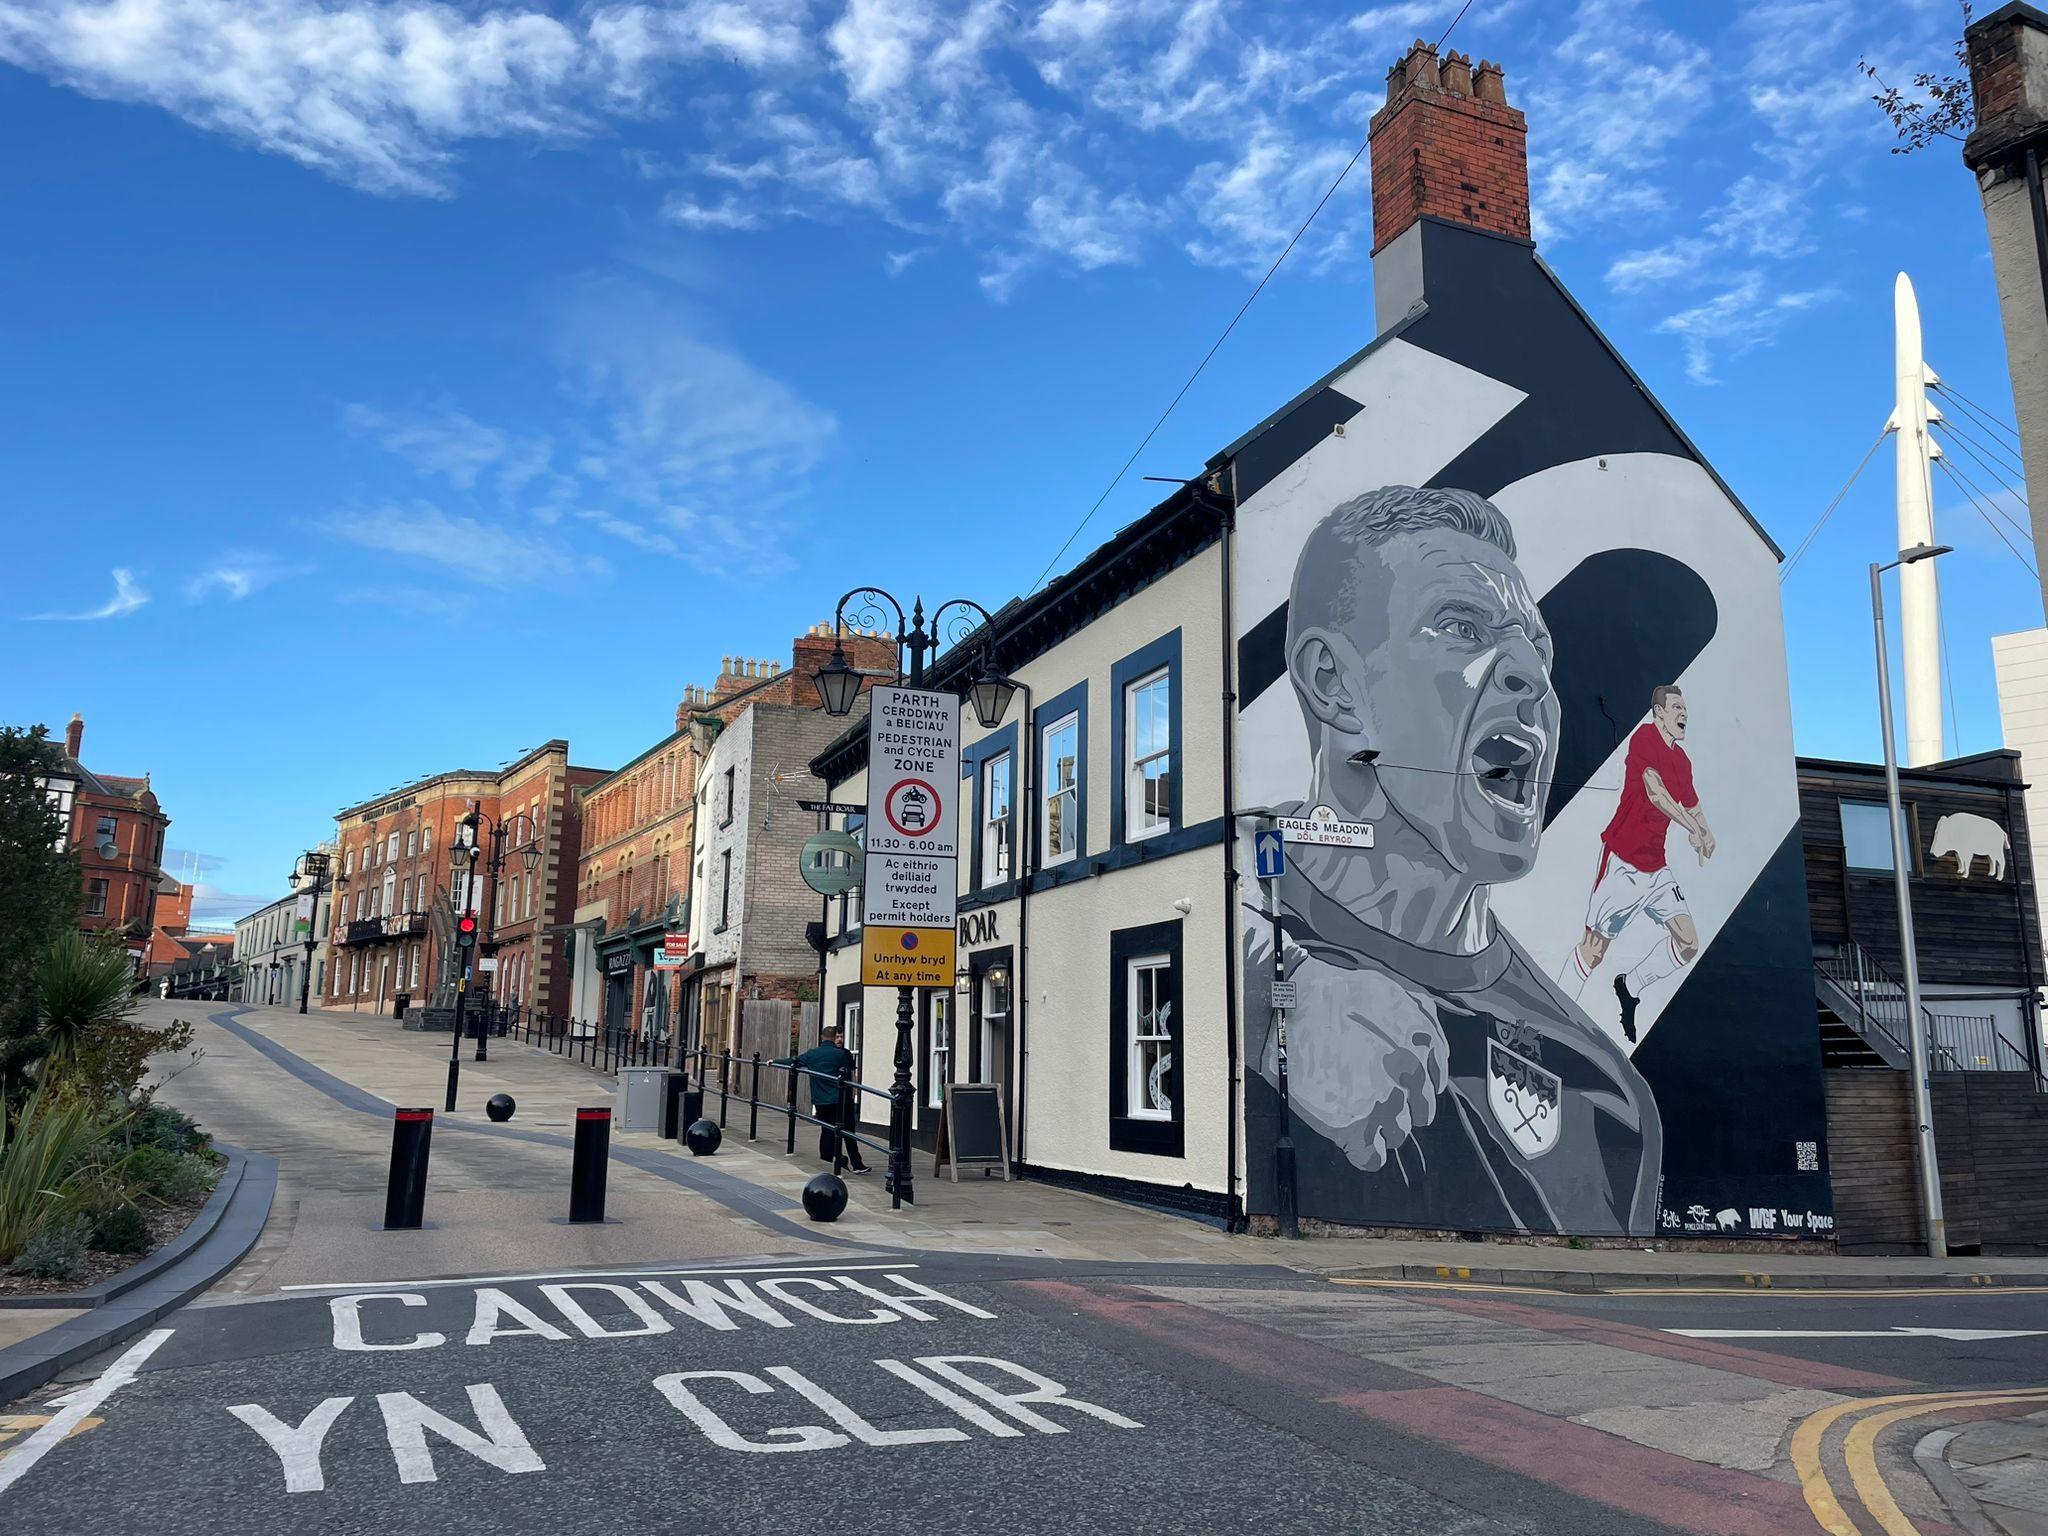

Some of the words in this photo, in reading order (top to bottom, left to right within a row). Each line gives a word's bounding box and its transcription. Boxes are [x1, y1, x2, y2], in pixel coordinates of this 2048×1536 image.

[893, 693, 939, 708] PARTH
[882, 705, 949, 721] CERDDWYR
[896, 719, 944, 731] BEICIAU
[877, 732, 952, 748] PEDESTRIAN
[884, 746, 903, 755] and
[907, 747, 945, 759] CYCLE
[894, 759, 934, 772] ZONE
[835, 805, 856, 813] BOAR
[1278, 820, 1318, 831] EAGLES
[1324, 823, 1369, 835] MEADOW
[1297, 830, 1314, 841] DÔL
[1319, 834, 1352, 844] ERYROD
[871, 838, 900, 848] 11.30
[908, 840, 935, 851] 6.00
[937, 844, 953, 852] am
[885, 859, 899, 869] Ac
[903, 860, 938, 871] eithrio
[891, 871, 931, 882] deiliaid
[885, 883, 937, 894] trwydded
[892, 899, 930, 911] Except
[869, 912, 906, 921] permit
[909, 912, 950, 923] holders
[959, 910, 1000, 948] BOAR
[873, 953, 917, 965] Unrhyw
[920, 954, 946, 966] bryd
[876, 970, 889, 980] At
[893, 973, 913, 982] any
[916, 971, 941, 981] time
[1780, 1209, 1803, 1227] Your
[1806, 1210, 1833, 1233] Space
[329, 1274, 998, 1350] CADWCH
[226, 1383, 546, 1493] YN
[652, 1355, 1146, 1452] GLIR
